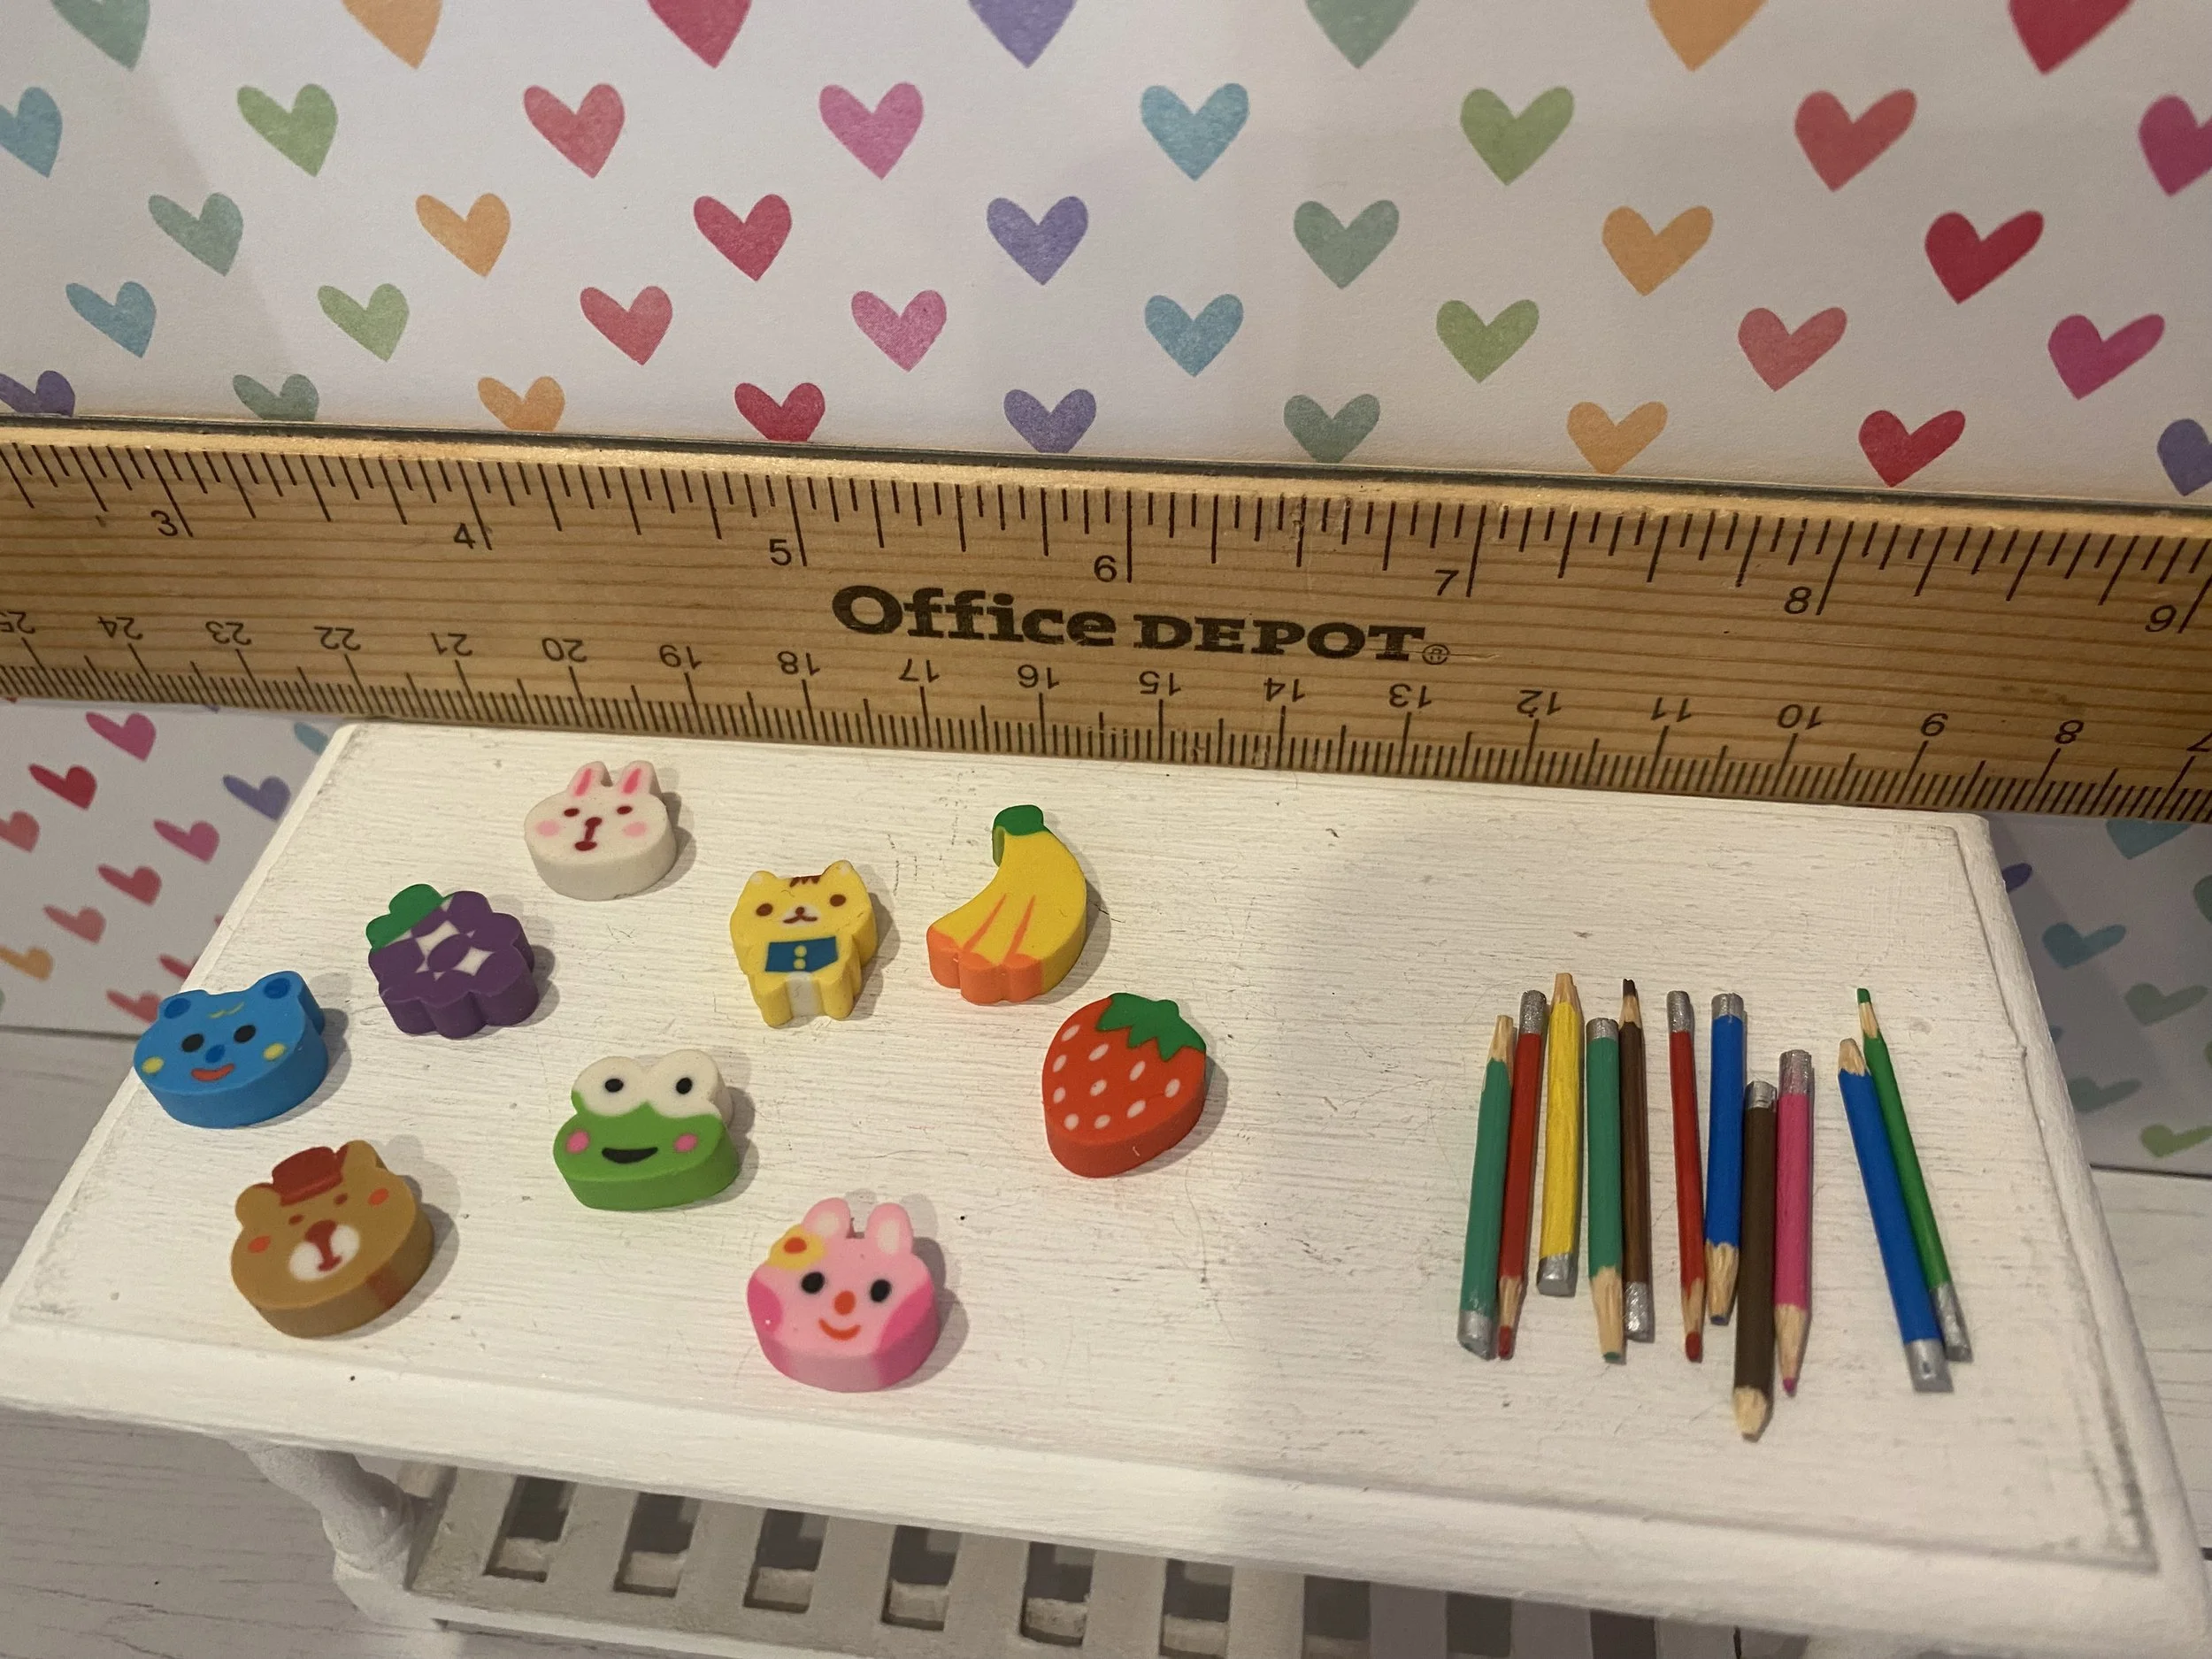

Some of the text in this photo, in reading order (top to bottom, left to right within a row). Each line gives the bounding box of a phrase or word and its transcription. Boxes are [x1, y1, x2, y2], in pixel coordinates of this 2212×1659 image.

[150, 510, 179, 537] 3
[453, 522, 476, 549] 4
[769, 538, 792, 566] 5
[1094, 555, 1118, 583] 6
[1434, 569, 1460, 596] 7
[1784, 586, 1812, 615] 8
[97, 616, 143, 641] 24
[832, 585, 1118, 648] Office
[2145, 604, 2177, 633] 9
[205, 620, 252, 646] 23
[313, 626, 361, 651] 22
[430, 632, 473, 657] 21
[541, 637, 588, 663] 20
[658, 644, 703, 670] 19
[777, 650, 820, 676] 18
[898, 658, 940, 683] 17
[1017, 664, 1060, 689] 16
[1139, 670, 1181, 696] 15
[1263, 677, 1306, 703] 14
[1389, 683, 1432, 709] 13
[1517, 689, 1562, 716] 12
[1650, 696, 1693, 723] 11
[1778, 703, 1822, 730] 10
[1920, 712, 1948, 737] 9
[2054, 719, 2085, 744] 8
